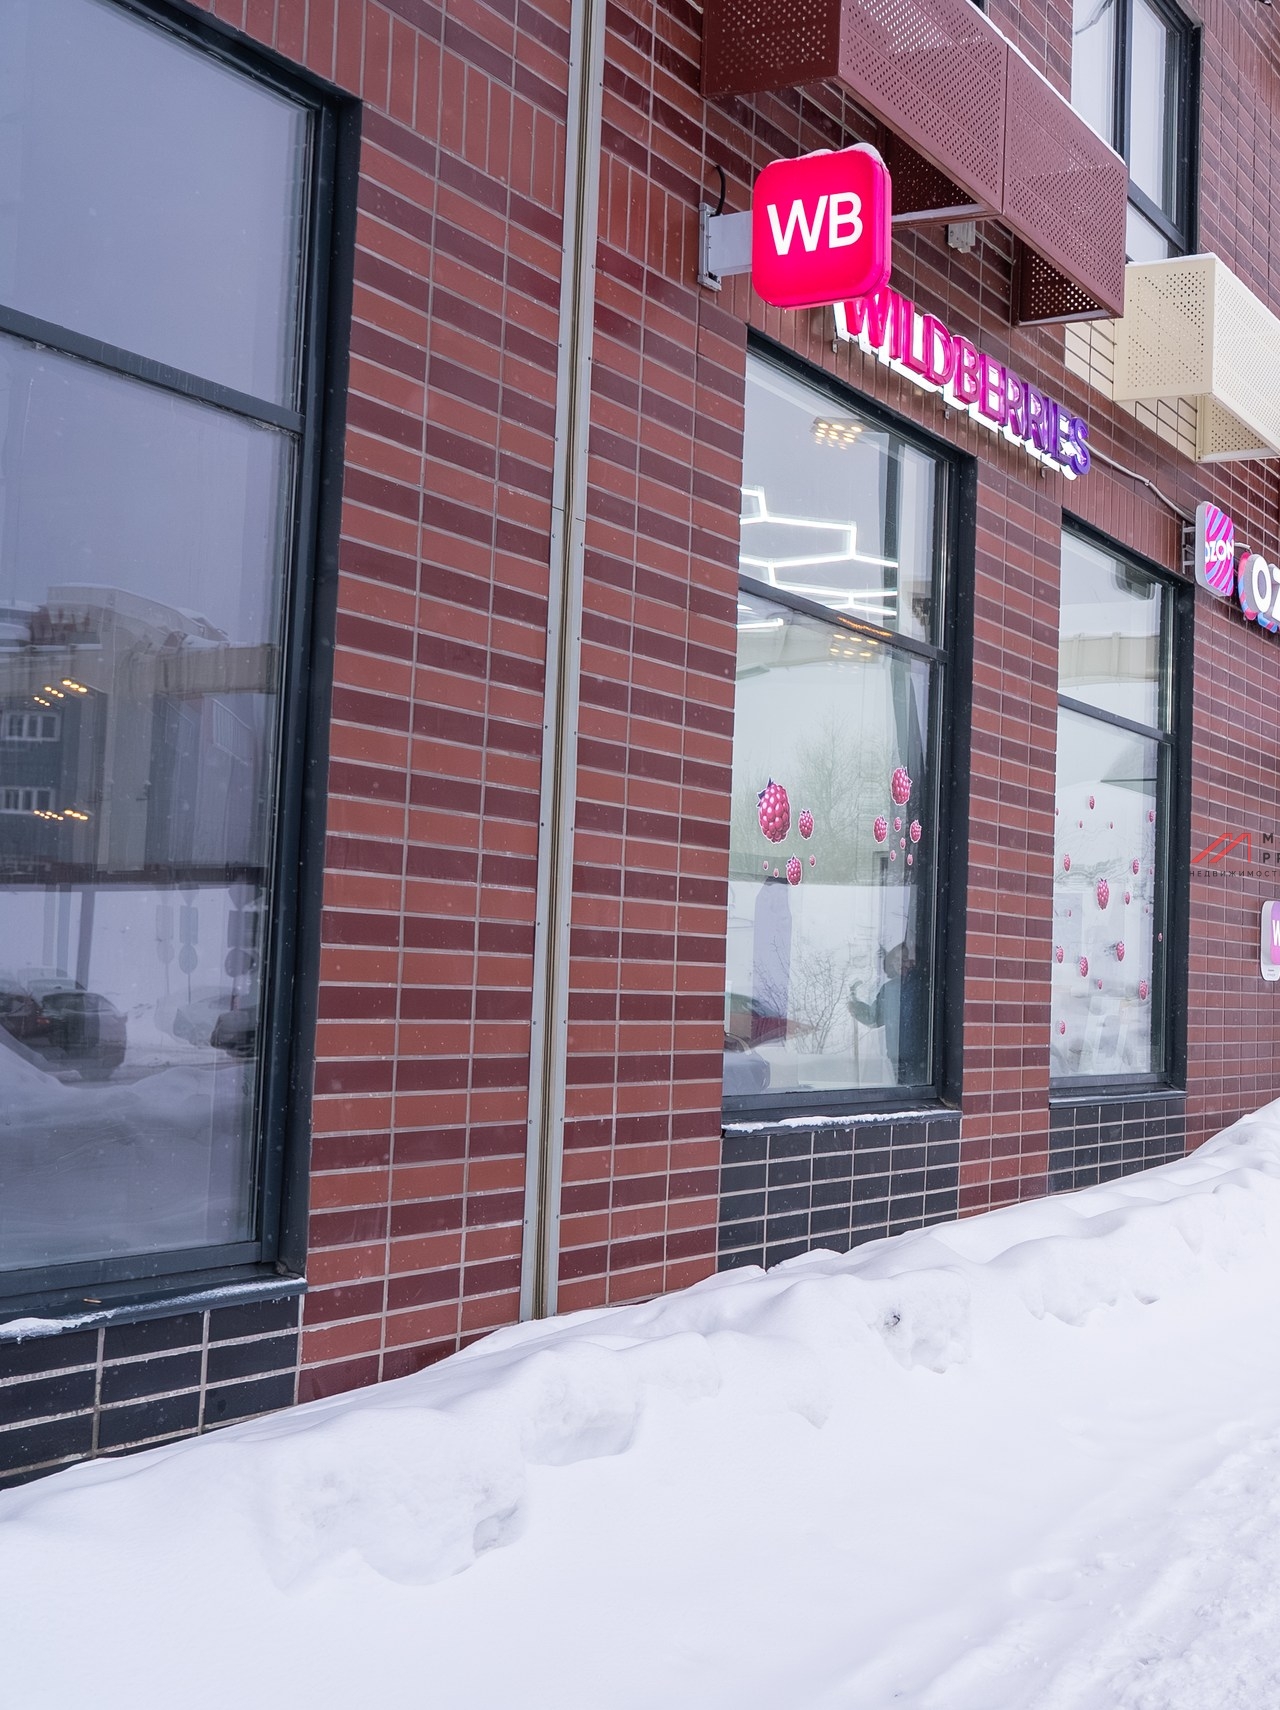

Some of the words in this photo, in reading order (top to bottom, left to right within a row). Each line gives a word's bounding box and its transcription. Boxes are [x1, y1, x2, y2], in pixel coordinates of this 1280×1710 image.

[766, 192, 863, 255] WB
[835, 286, 1091, 478] WILDBERRIES
[1205, 539, 1234, 563] OZON
